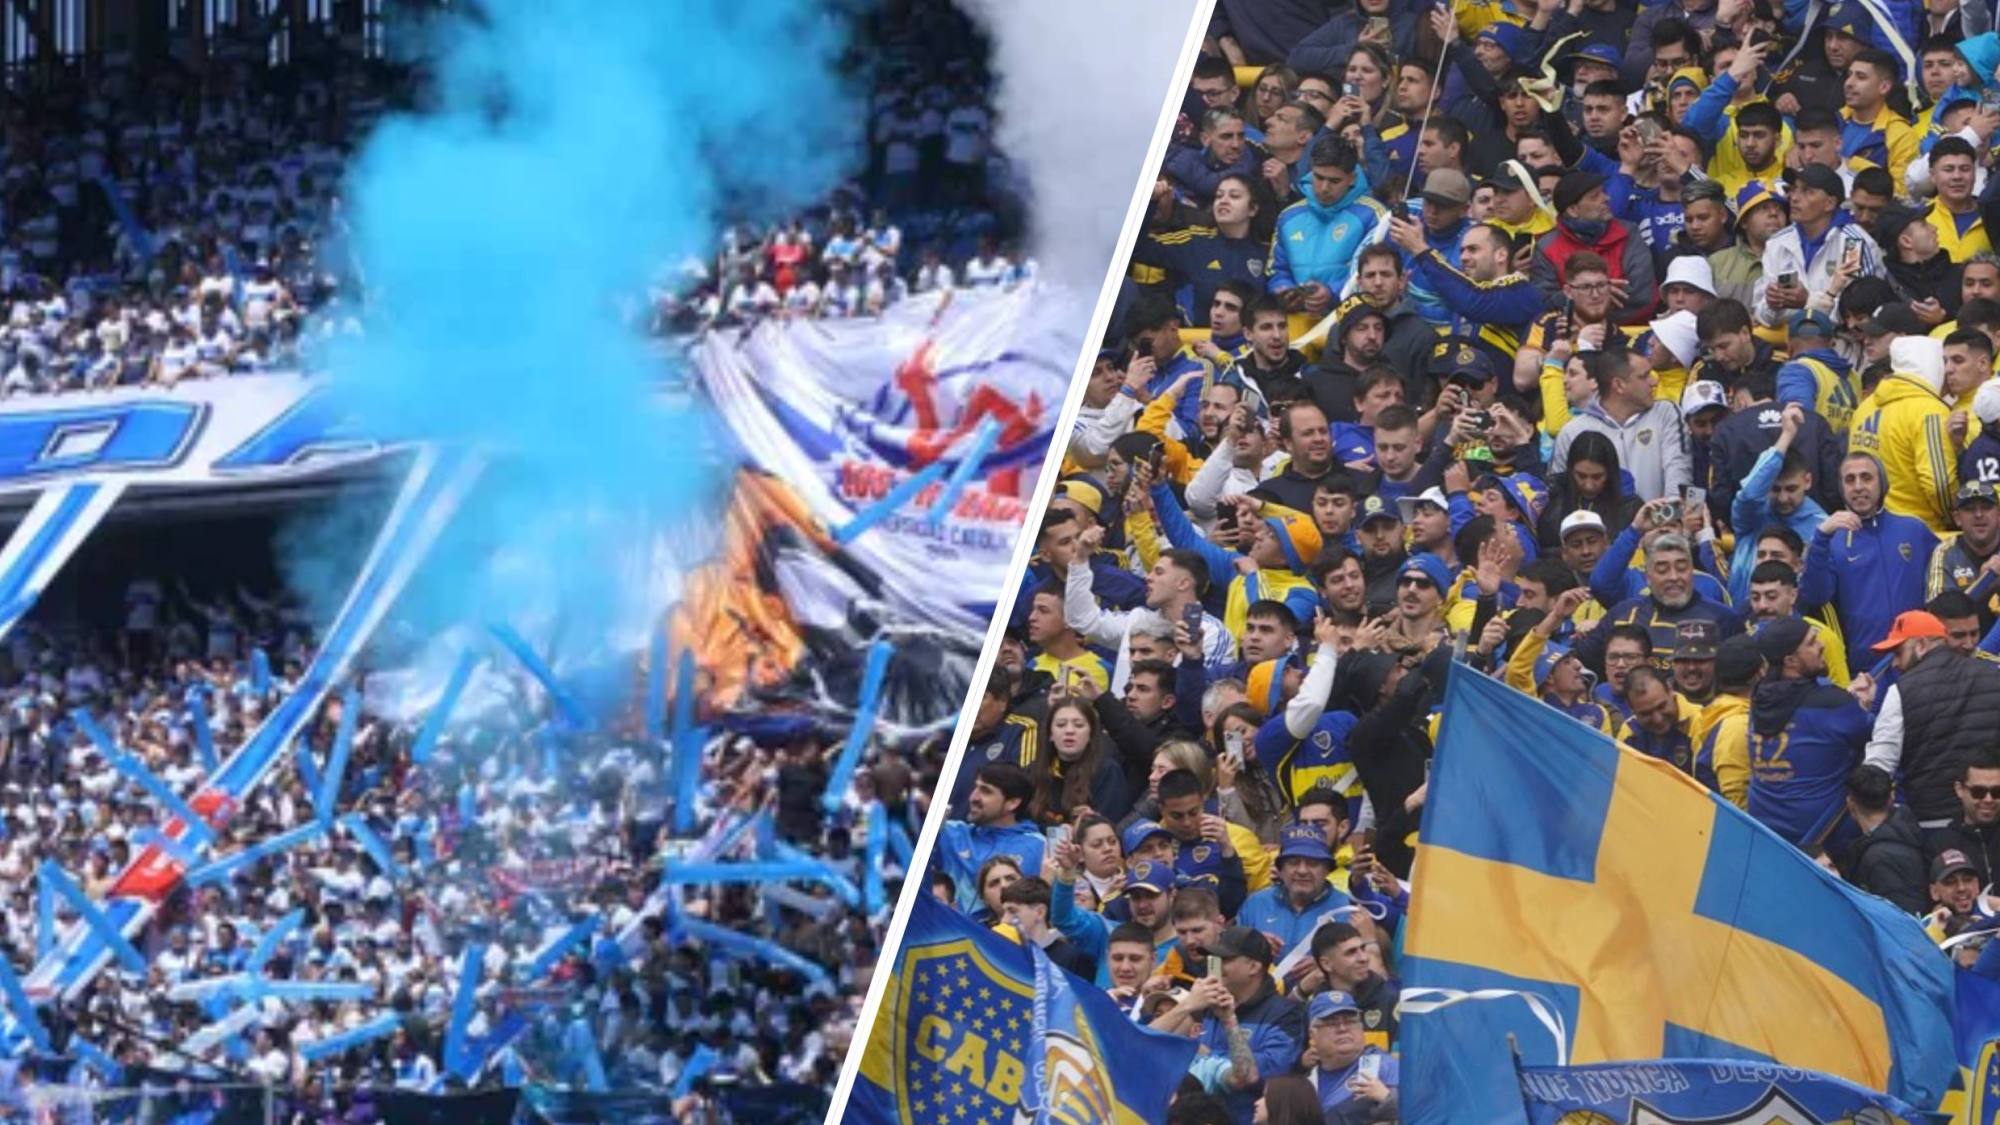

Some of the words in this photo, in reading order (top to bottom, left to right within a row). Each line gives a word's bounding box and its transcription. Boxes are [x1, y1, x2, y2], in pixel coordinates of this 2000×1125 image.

[1976, 456, 2000, 482] 12
[1751, 731, 1792, 769] 12
[1576, 1063, 1690, 1105] NUNCA
